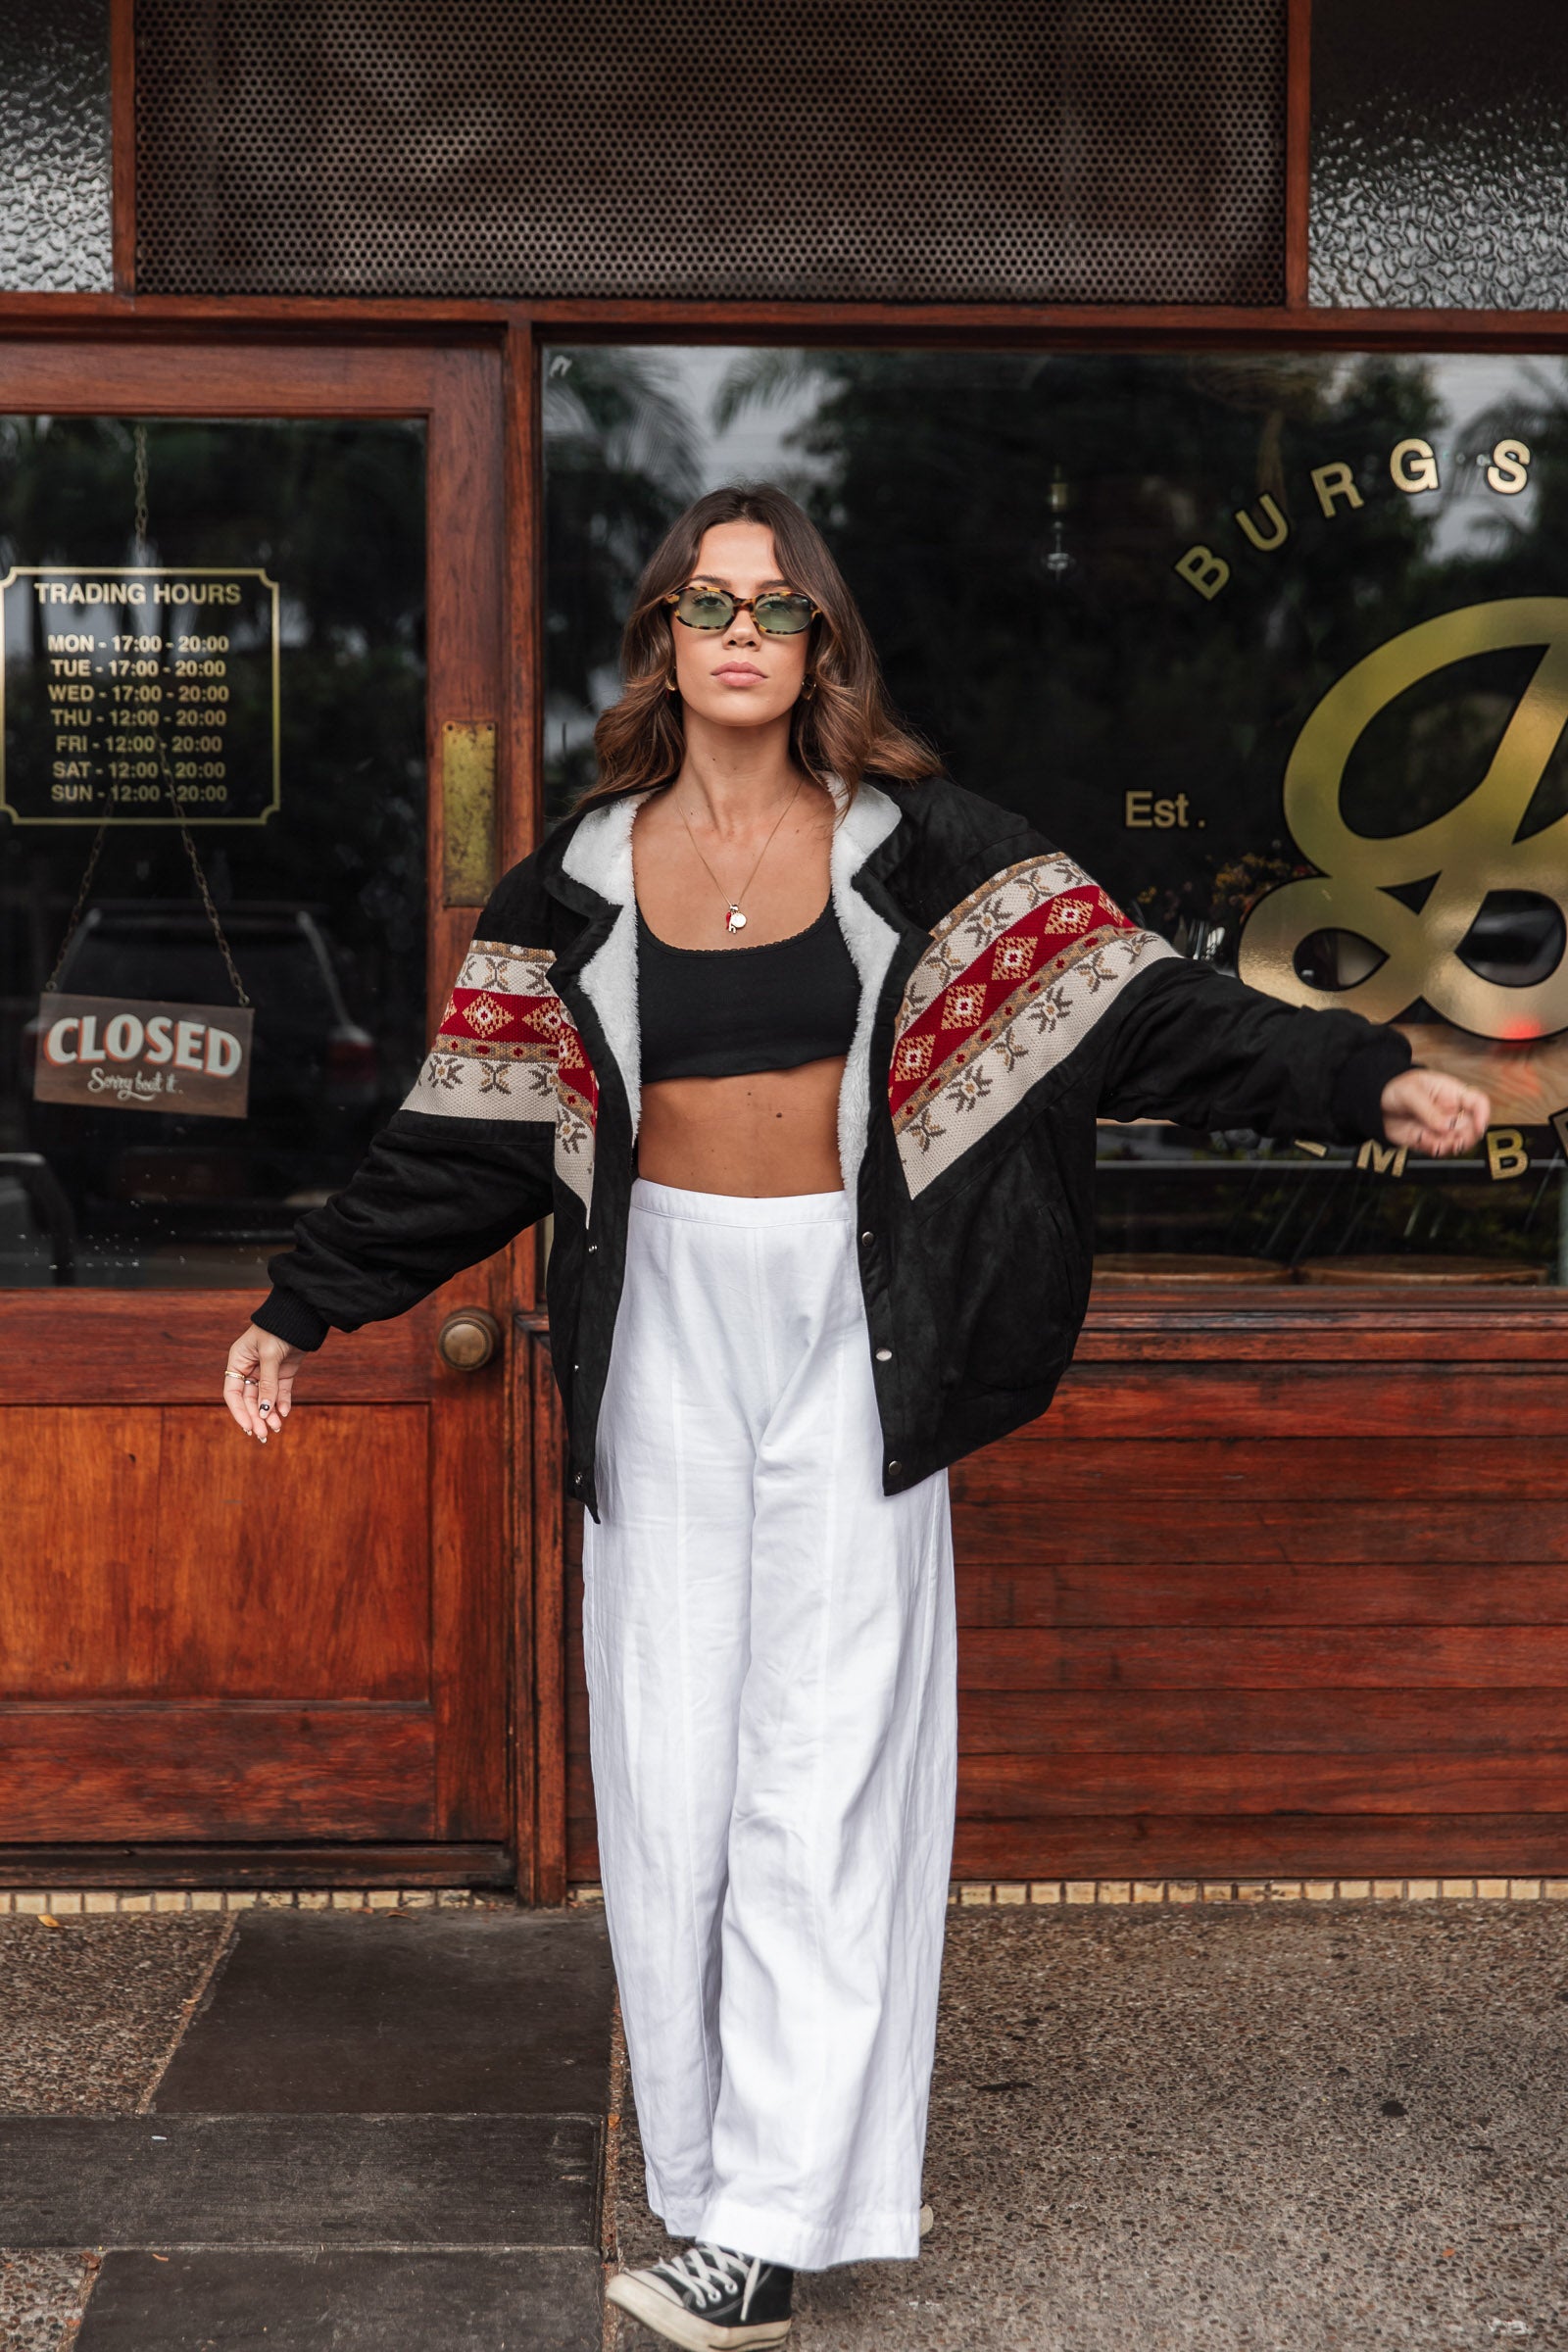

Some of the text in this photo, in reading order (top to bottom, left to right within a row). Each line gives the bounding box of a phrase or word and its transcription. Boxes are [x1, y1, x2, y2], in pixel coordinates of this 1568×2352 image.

[34, 583, 242, 605] TRADING HOURS
[48, 634, 94, 652] MON
[112, 634, 162, 652] 17:00
[178, 634, 229, 652] 20:00
[51, 660, 91, 676] TUE
[109, 660, 159, 676] 17:00
[175, 660, 225, 676] 20:00
[48, 685, 94, 702] WED
[112, 685, 162, 702] 17:00
[178, 685, 229, 702] 20:00
[51, 709, 91, 726] THU
[110, 709, 160, 726] 12:00
[175, 709, 227, 726] 20:00
[56, 735, 87, 753] FRI
[106, 735, 155, 753] 12:00
[172, 735, 222, 753] 20:00
[53, 761, 89, 778] SAT
[109, 761, 158, 778] 12:00
[175, 761, 225, 778] 20:00
[51, 785, 92, 802] SUN
[111, 785, 160, 802] 12:00
[176, 785, 227, 802] 20:00
[1125, 790, 1205, 828] Est.
[44, 1013, 242, 1078] CLOSED
[87, 1066, 156, 1102] Sorry
